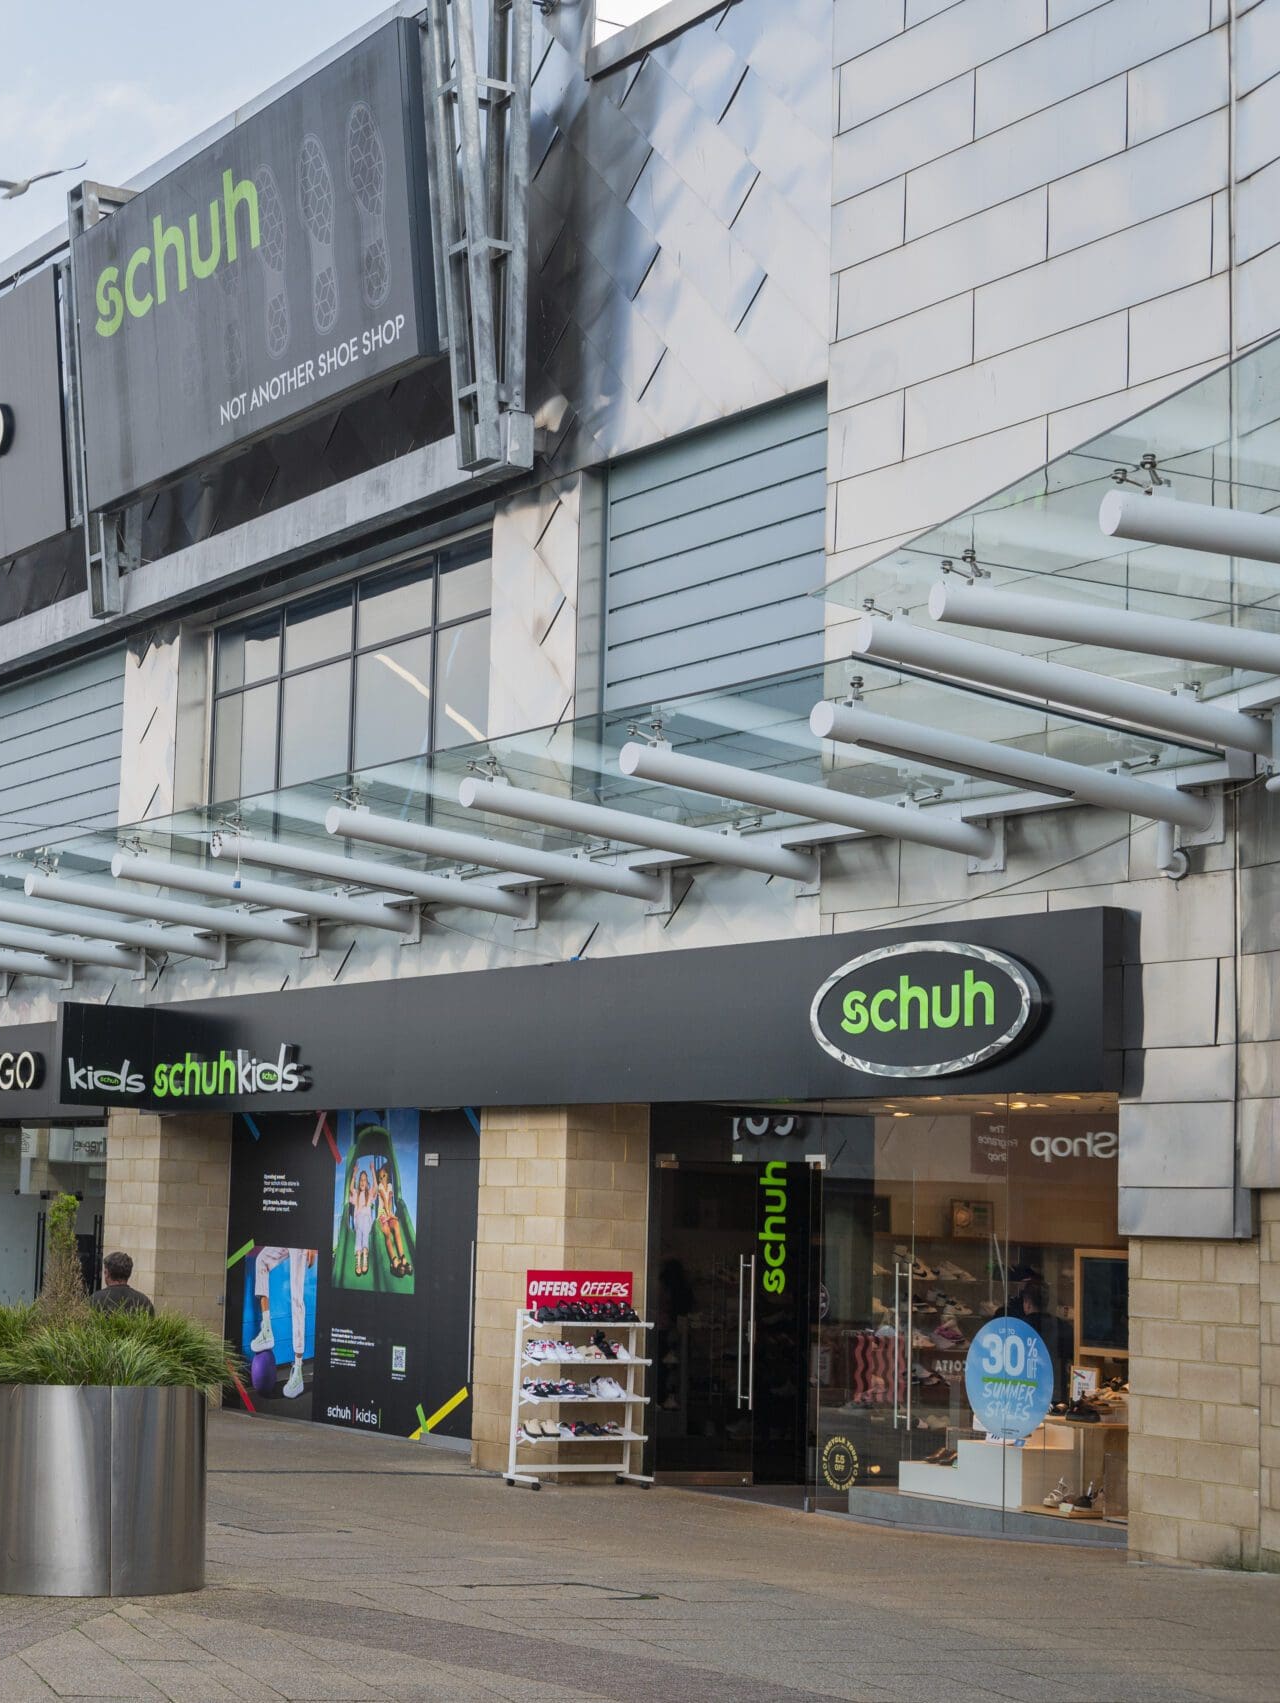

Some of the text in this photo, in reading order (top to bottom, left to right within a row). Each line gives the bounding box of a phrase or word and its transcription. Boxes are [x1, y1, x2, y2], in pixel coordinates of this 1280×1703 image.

[95, 168, 261, 337] schuh
[219, 314, 405, 425] NOT ANOTHER SHOE SHOP
[840, 969, 995, 1034] schuh
[68, 1056, 146, 1093] kids
[758, 1160, 788, 1296] schuh
[528, 1280, 630, 1298] OFFERS OFFERS
[982, 1381, 1037, 1406] SUMMER
[984, 1401, 1031, 1422] STYLES
[327, 1405, 378, 1425] schuh kids
